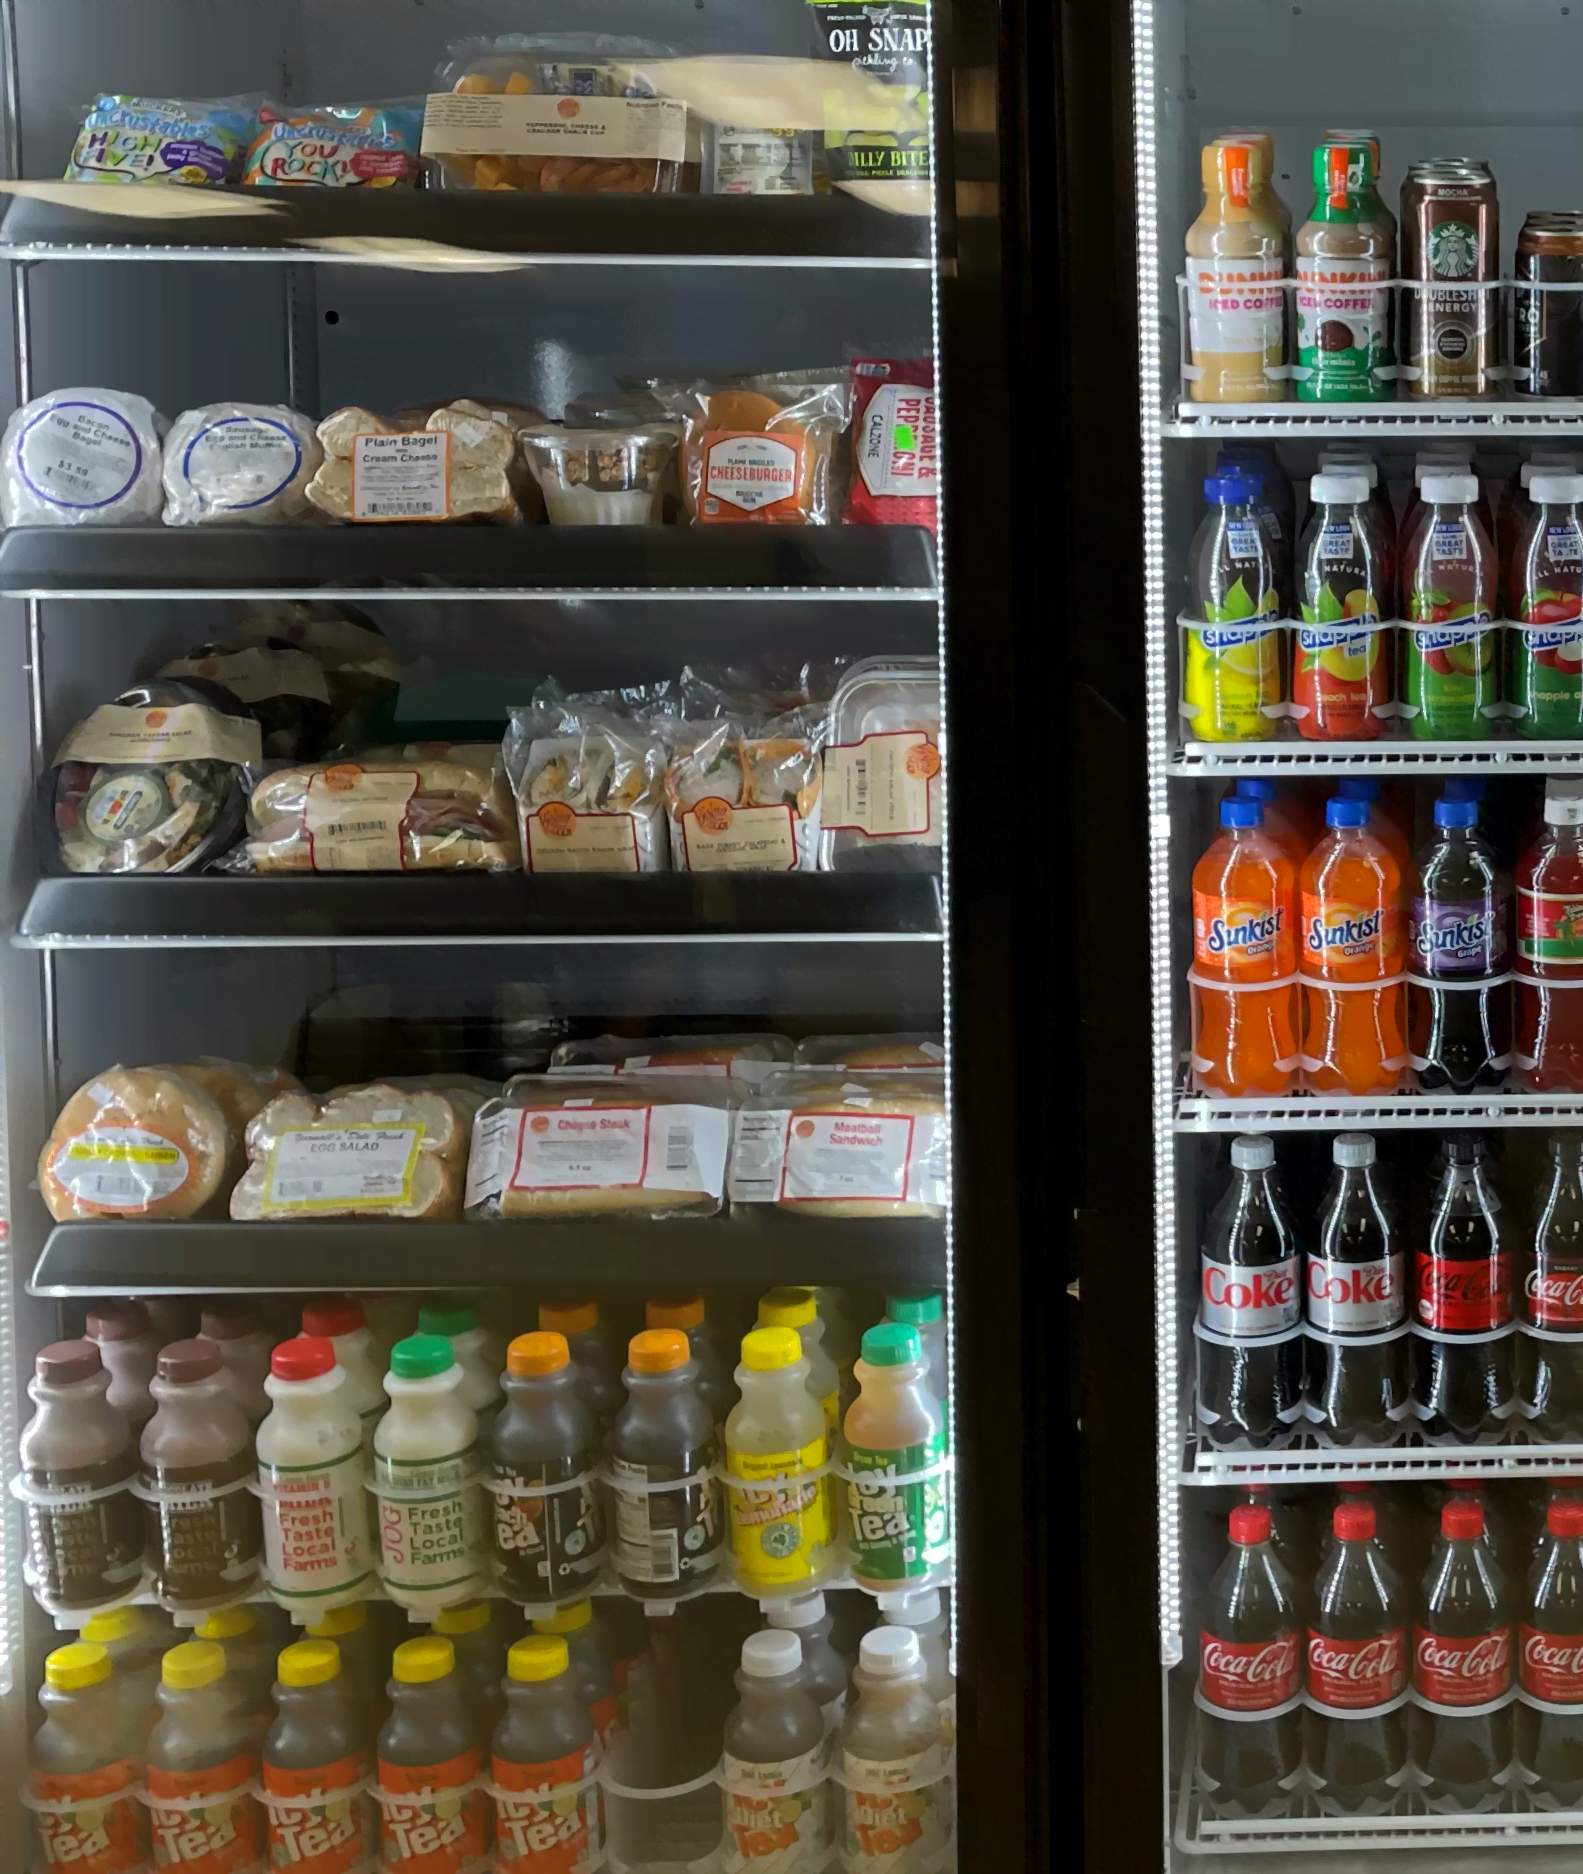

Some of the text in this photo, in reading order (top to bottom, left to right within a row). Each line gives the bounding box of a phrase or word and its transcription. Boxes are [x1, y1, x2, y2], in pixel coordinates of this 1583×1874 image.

[829, 28, 928, 53] OH SNAP
[852, 54, 898, 72] pickling
[88, 131, 163, 153] HIGH
[284, 140, 341, 159] YOU
[79, 147, 155, 171] FIVE!
[270, 156, 352, 183] ROCK!
[1437, 188, 1469, 196] MOCHA
[1208, 298, 1240, 310] ICED
[1428, 302, 1478, 313] ENERGY
[77, 415, 110, 431] Bacon
[72, 422, 92, 434] and
[93, 429, 131, 447] Cheese
[72, 431, 102, 447] Bagel
[364, 436, 438, 448] Plain Bagel
[866, 414, 884, 459] CALZONE
[362, 453, 439, 463] Cream Cheese
[709, 466, 793, 483] CHEESEBURGER
[1347, 645, 1366, 657] tea
[1208, 908, 1284, 955] Sunkist
[1308, 908, 1385, 953] Sunkist
[1416, 908, 1493, 958] Sunkist
[1246, 939, 1277, 957] Orange
[1343, 940, 1375, 957] Orange
[1457, 944, 1483, 960] Grape
[600, 1118, 631, 1130] Steak
[833, 1121, 882, 1135] Meatball
[310, 1141, 380, 1153] EGG SALAD
[829, 1133, 884, 1147] Sandwich
[1263, 1268, 1288, 1282] Diet
[1307, 1261, 1395, 1305] Coke
[1204, 1266, 1296, 1310] Coke
[279, 1510, 334, 1526] Fresh
[408, 1501, 462, 1521] Fresh
[409, 1516, 464, 1536] Taste
[851, 1507, 910, 1542] Tea
[281, 1526, 335, 1543] Taste
[410, 1529, 464, 1551] Local
[281, 1538, 336, 1557] Local
[410, 1546, 466, 1565] Farms
[283, 1556, 338, 1572] Farms
[1203, 1641, 1297, 1683] Coca-Cola
[1308, 1637, 1399, 1680] Coca-Cola
[1417, 1637, 1507, 1678] Coca-Cola
[157, 1820, 237, 1864] Tea
[275, 1815, 355, 1863] Tea
[389, 1812, 466, 1859] Tea
[504, 1809, 582, 1856] Tea
